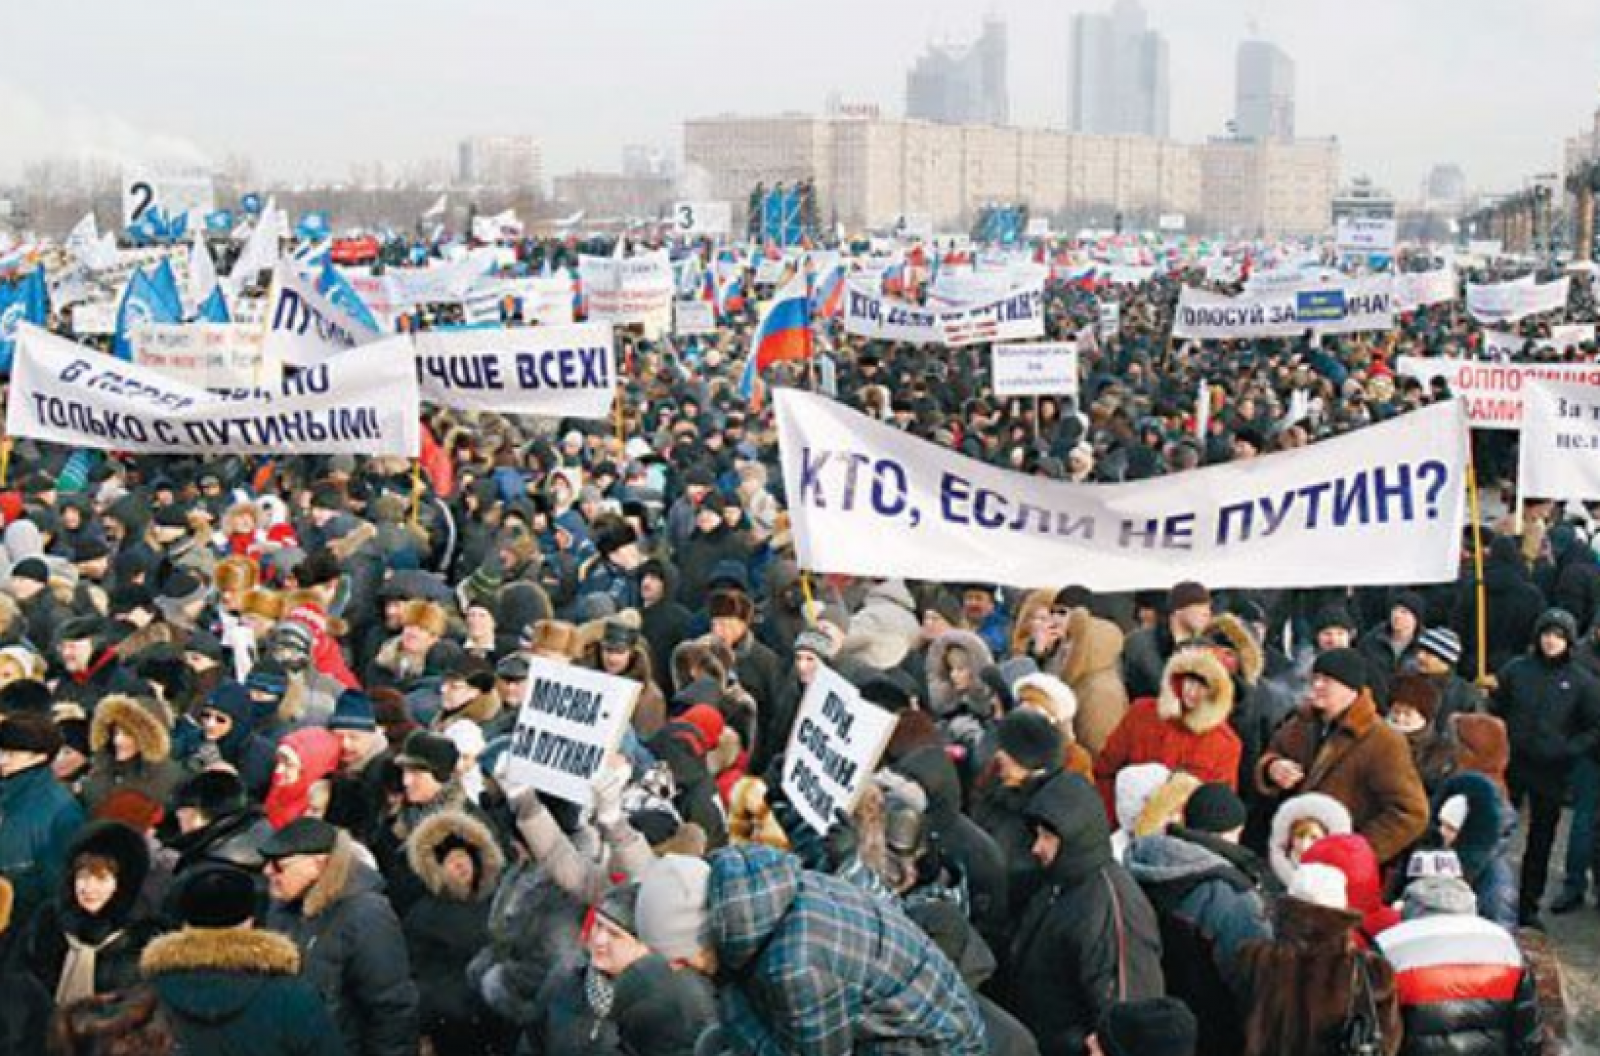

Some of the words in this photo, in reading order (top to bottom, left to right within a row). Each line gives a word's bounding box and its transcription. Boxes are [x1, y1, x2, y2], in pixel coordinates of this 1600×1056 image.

[680, 205, 694, 229] 3
[415, 354, 504, 389] ЧШЕ
[515, 347, 608, 389] ВСЕХ!
[33, 393, 146, 443] ТОЛЬКО
[155, 422, 179, 445] С
[187, 408, 381, 447] ПУТИНЫМ!
[800, 446, 920, 527] КТО,
[940, 471, 1095, 539] ЕСЛИ
[1119, 513, 1196, 549] НЕ
[1216, 460, 1448, 545] ПУТИН?
[529, 678, 603, 727] МОСКВА
[511, 722, 535, 760] ЗА
[531, 729, 604, 779] ПУТИНА!
